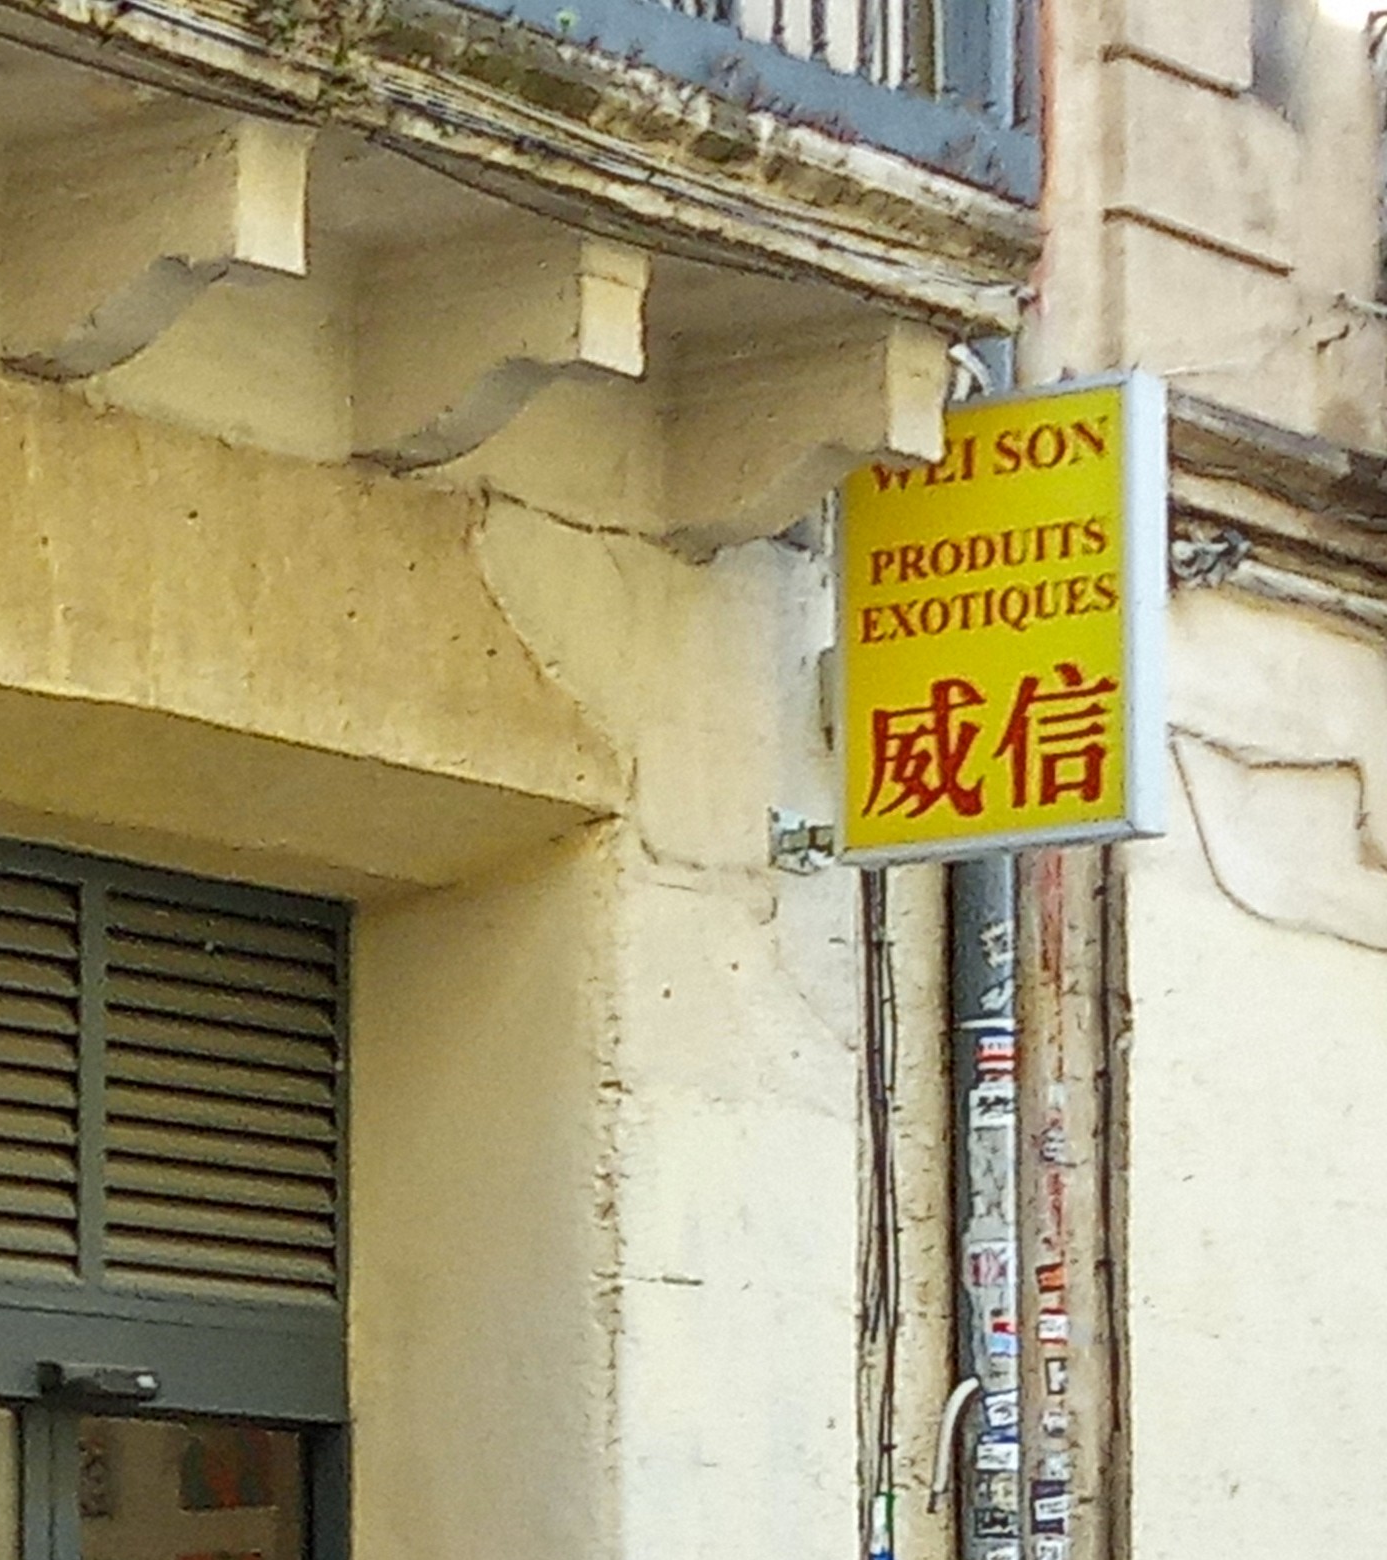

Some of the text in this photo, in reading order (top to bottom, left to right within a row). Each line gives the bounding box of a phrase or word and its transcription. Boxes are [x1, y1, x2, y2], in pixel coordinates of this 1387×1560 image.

[993, 417, 1109, 476] SON
[869, 519, 1107, 585] PRODUITS
[859, 573, 1120, 645] EXOTIQUES
[861, 661, 1120, 819] 威信
